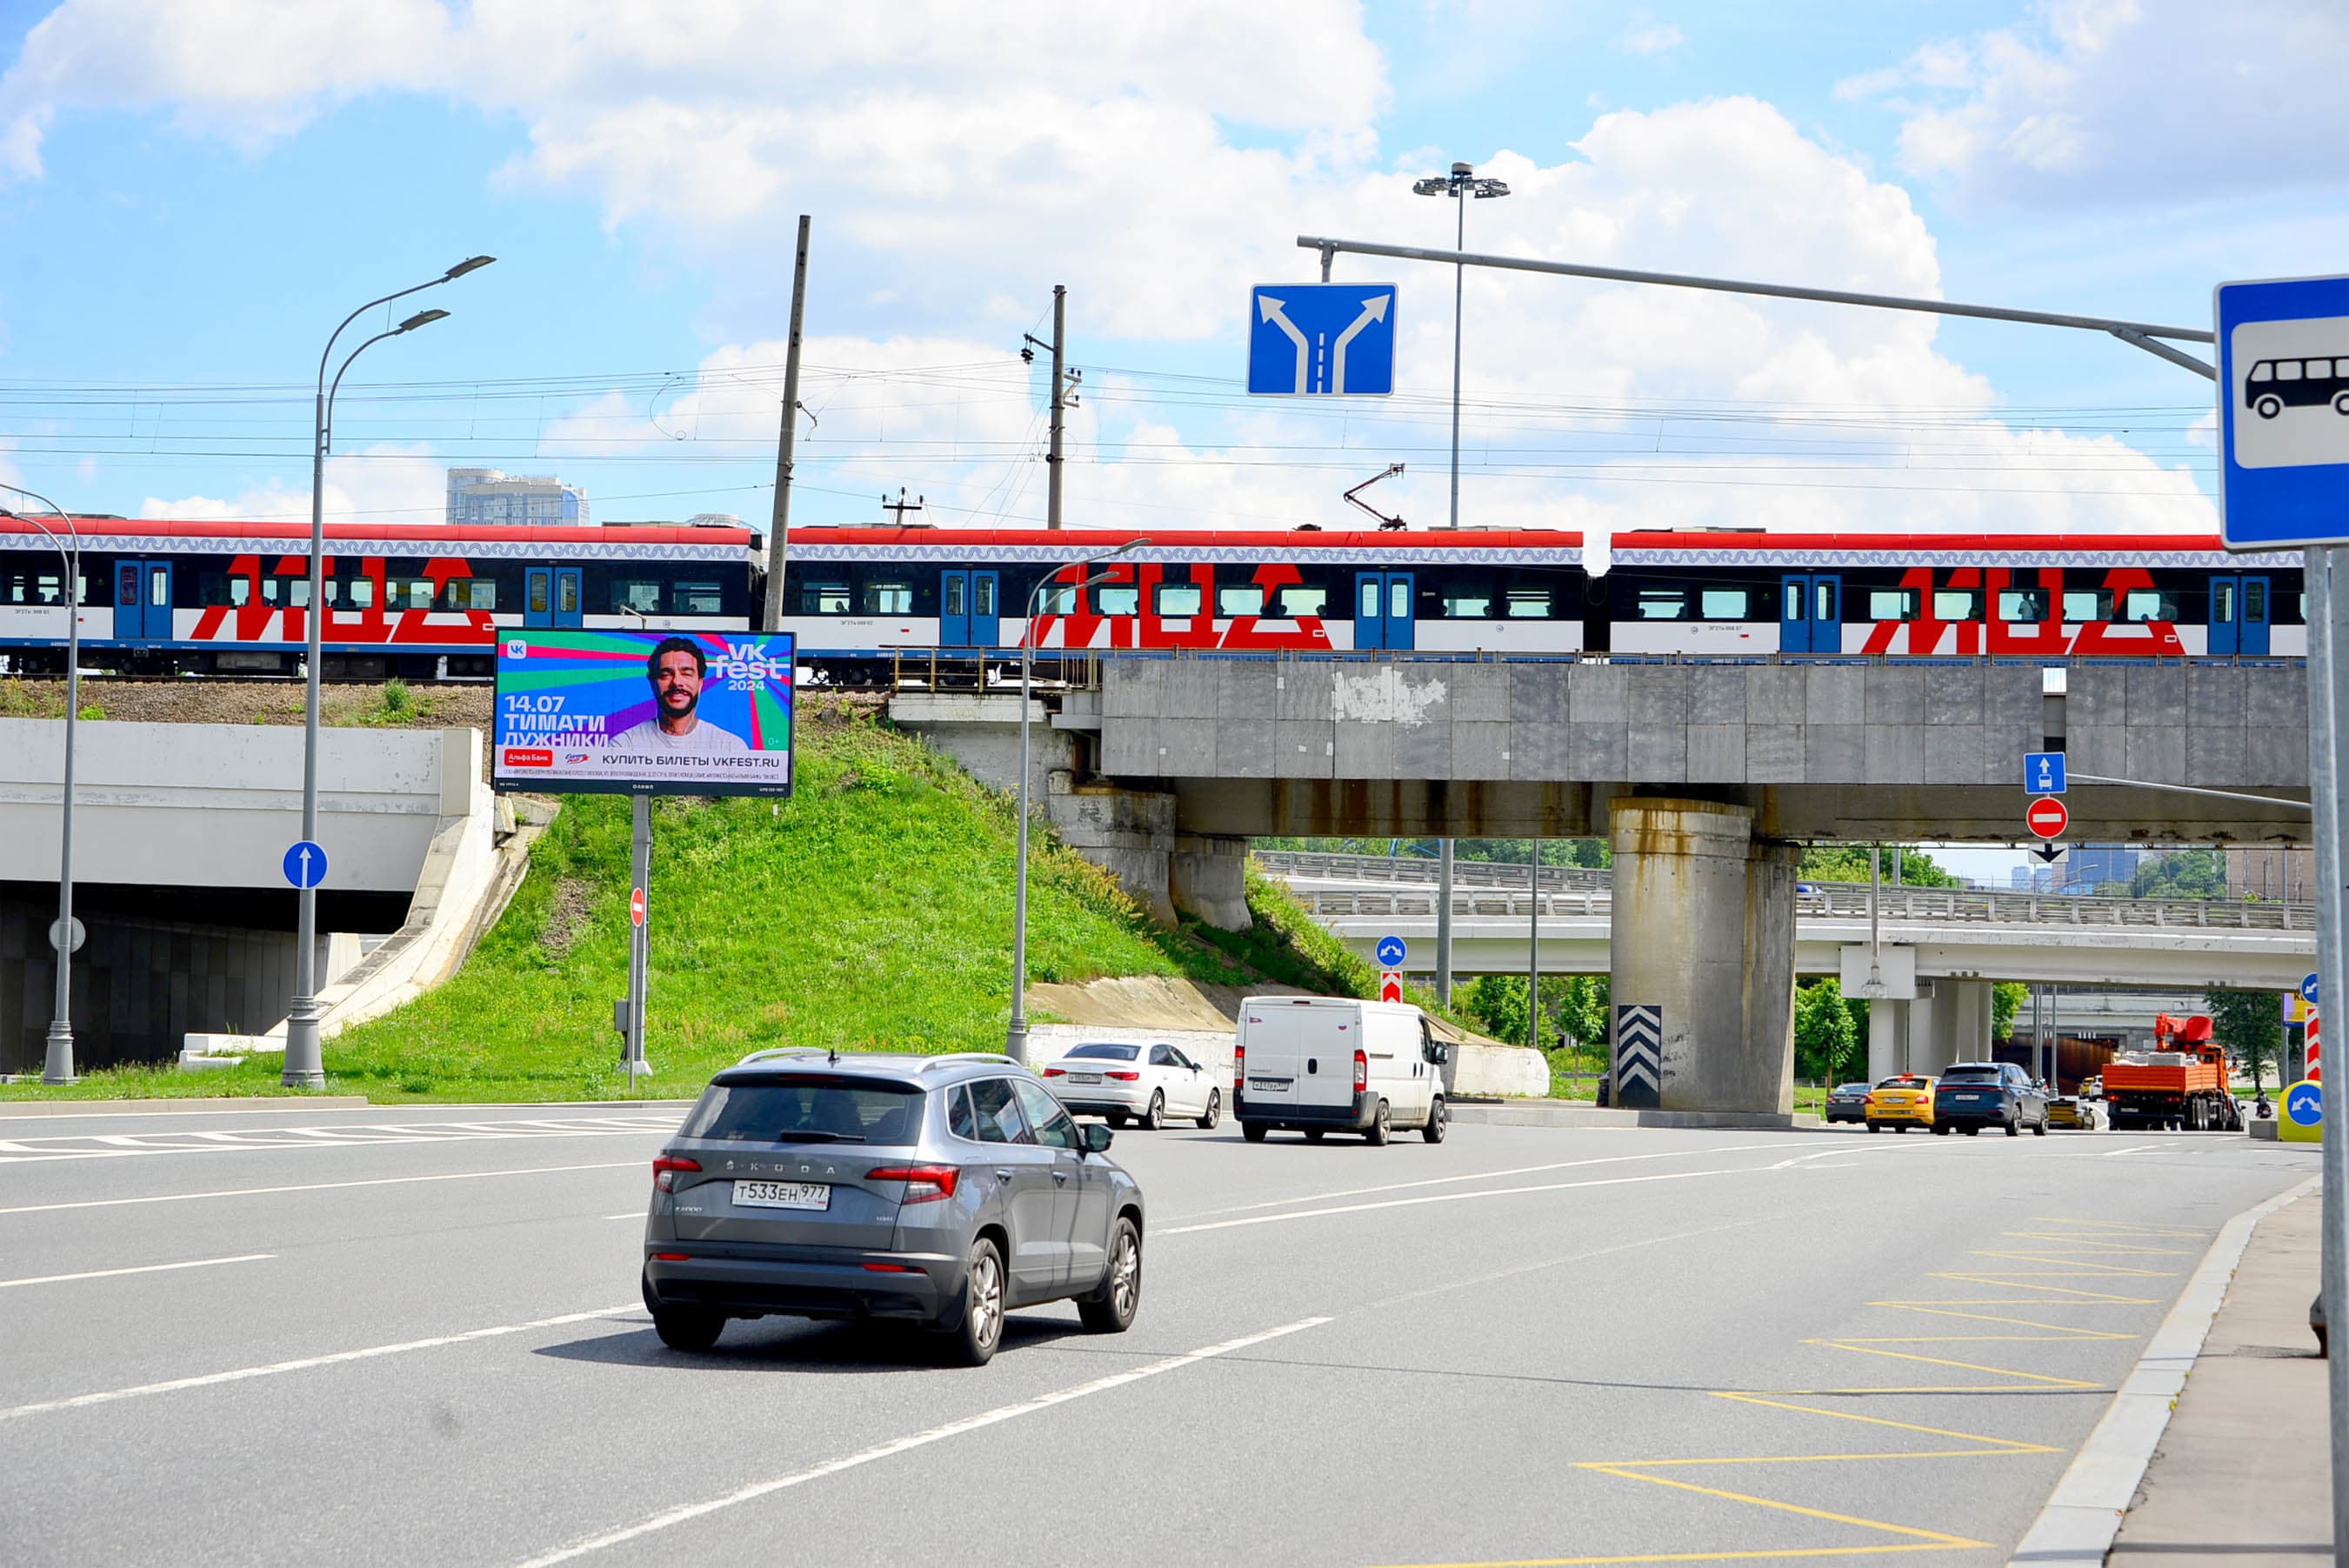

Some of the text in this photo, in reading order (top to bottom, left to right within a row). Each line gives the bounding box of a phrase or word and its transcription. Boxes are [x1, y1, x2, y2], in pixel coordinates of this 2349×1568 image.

[510, 644, 524, 655] VK
[729, 643, 767, 661] VK
[715, 654, 784, 680] fest
[728, 680, 765, 691] 2024
[504, 695, 566, 713] 14.07
[504, 713, 605, 732] ТИМАТИ
[504, 731, 609, 748] ЛУЖНИКИ
[768, 737, 779, 745] 0+
[508, 753, 530, 763] Альфа
[602, 754, 653, 765] КУПИТЬ
[656, 756, 710, 766] БИЛЕТЫ
[712, 757, 780, 768] VKFEST.RU
